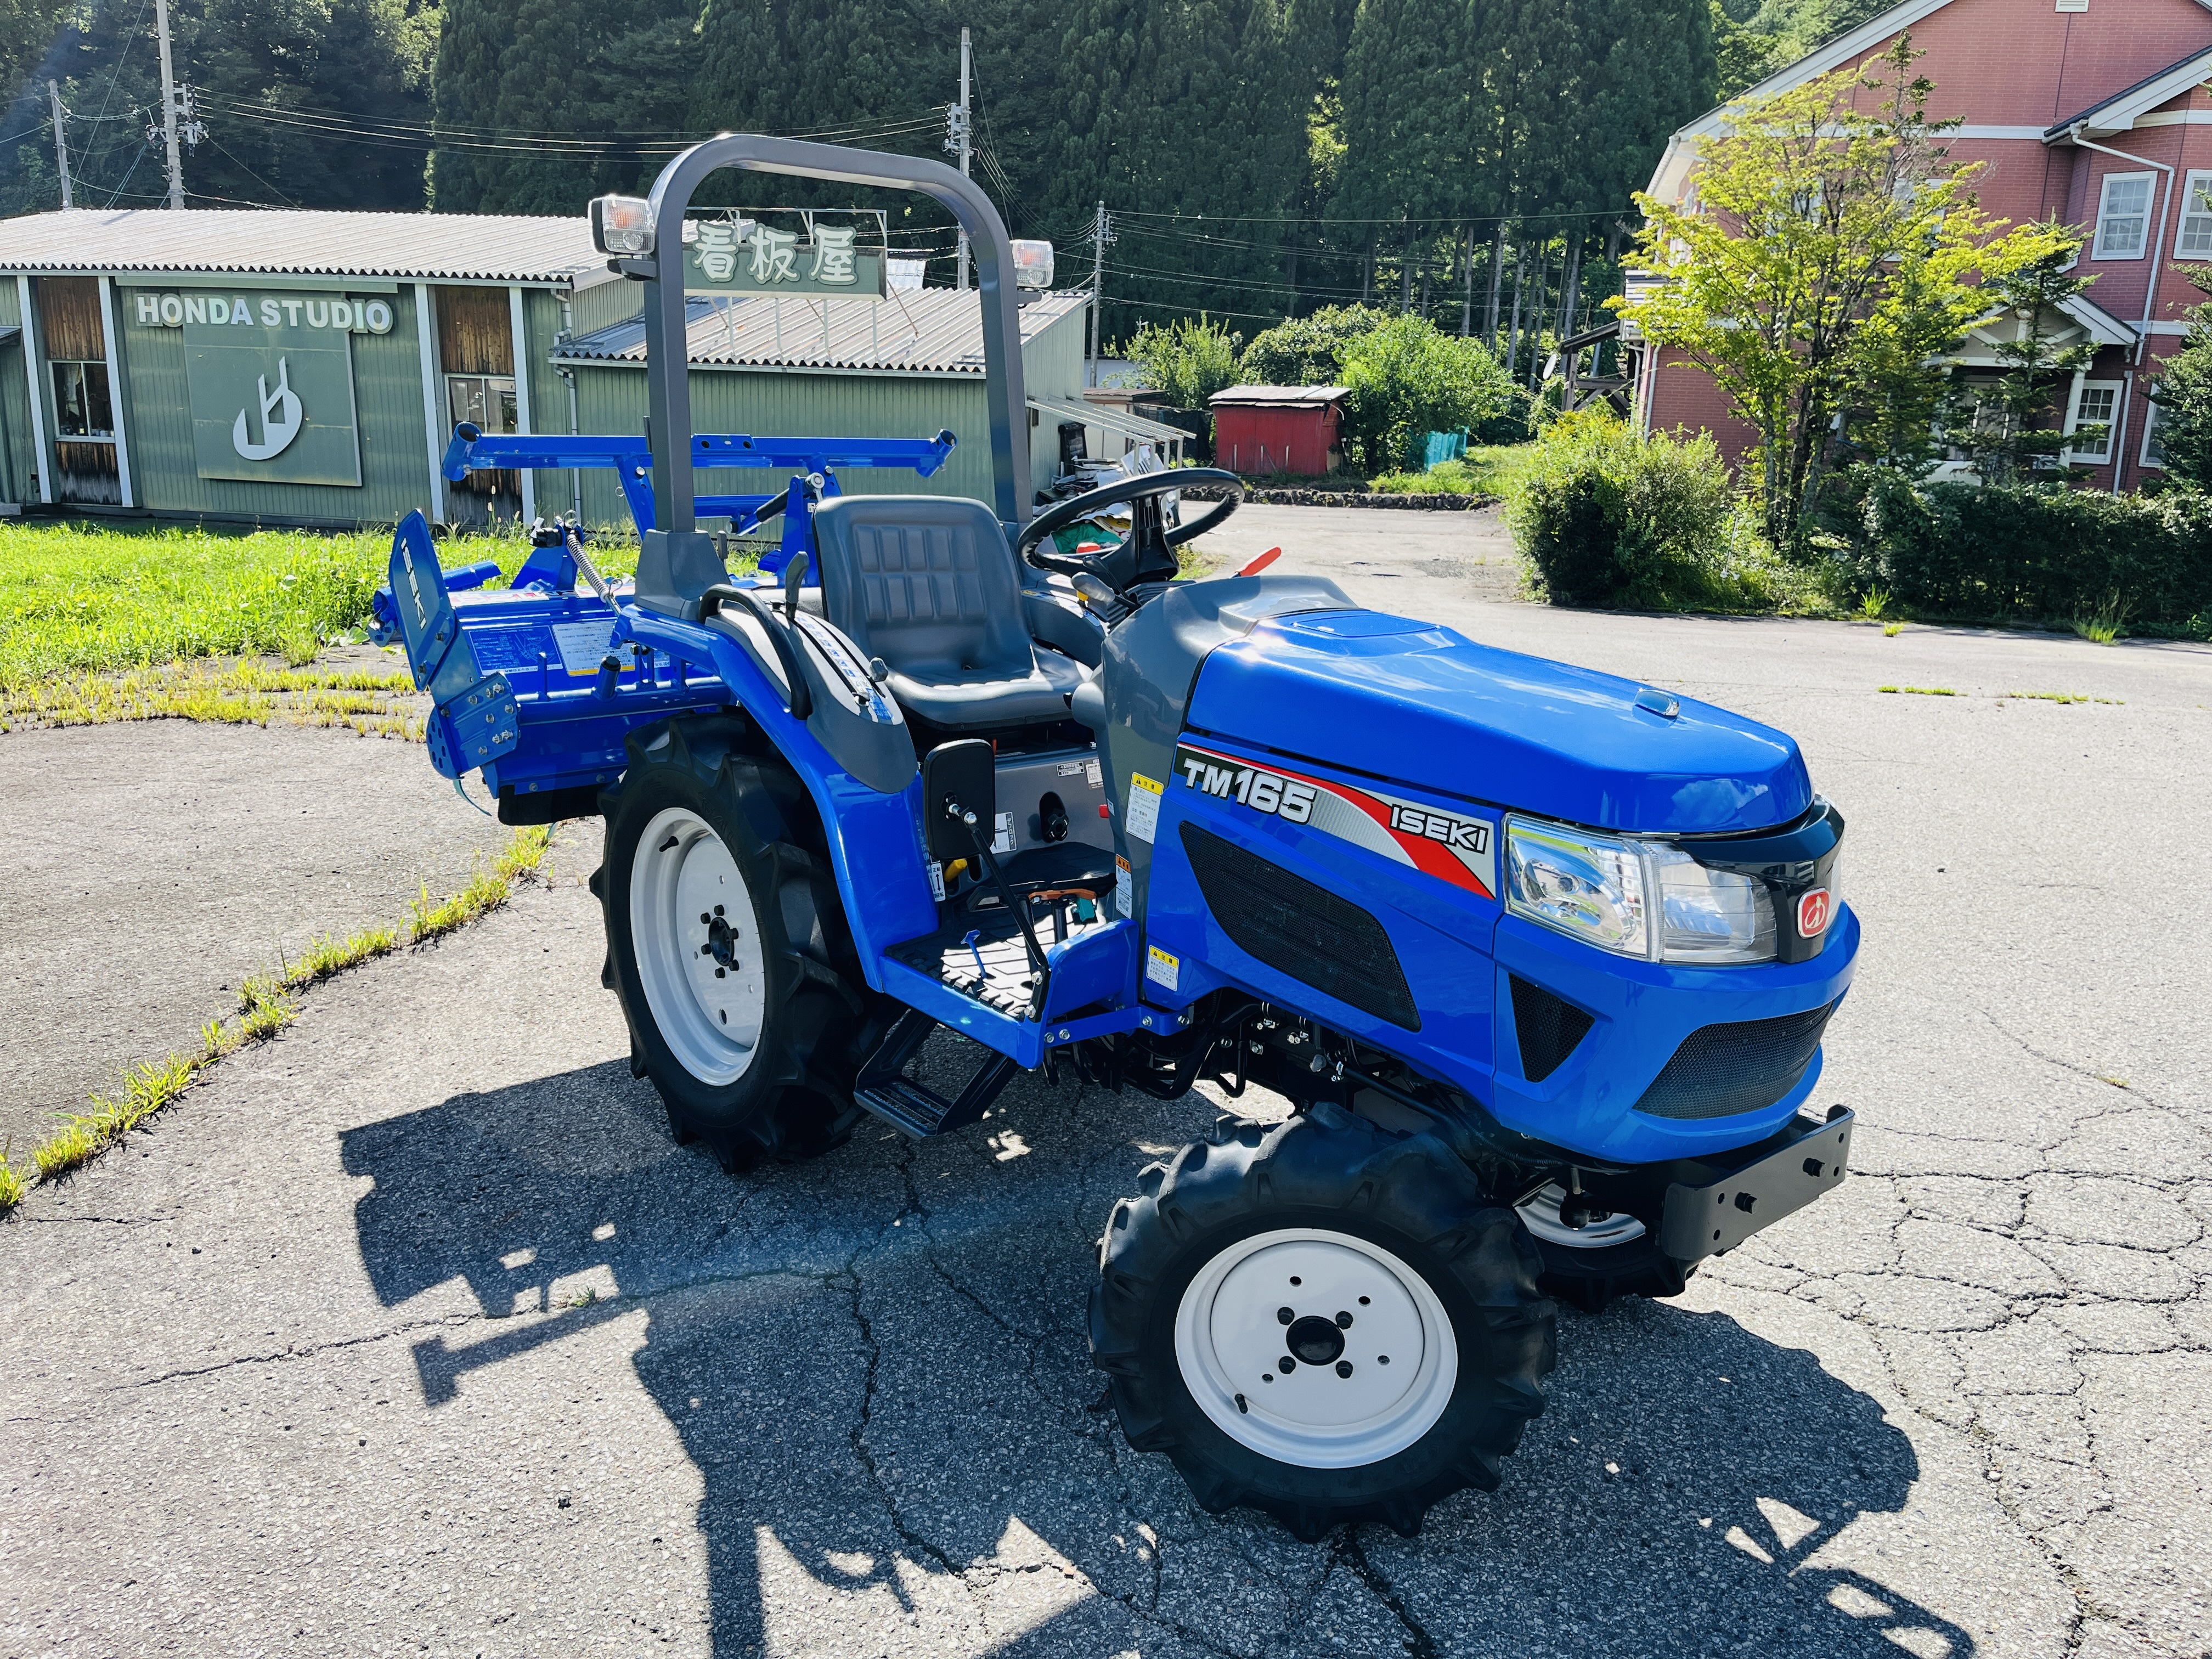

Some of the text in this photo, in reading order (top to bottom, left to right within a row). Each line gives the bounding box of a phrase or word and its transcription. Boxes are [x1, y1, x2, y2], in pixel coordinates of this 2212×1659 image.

[694, 224, 856, 281] 看板屋
[137, 296, 391, 330] HONDA STUDIO
[400, 537, 426, 630] ISEKI
[1183, 758, 1317, 824] TM165
[1390, 805, 1487, 853] ISEKI
